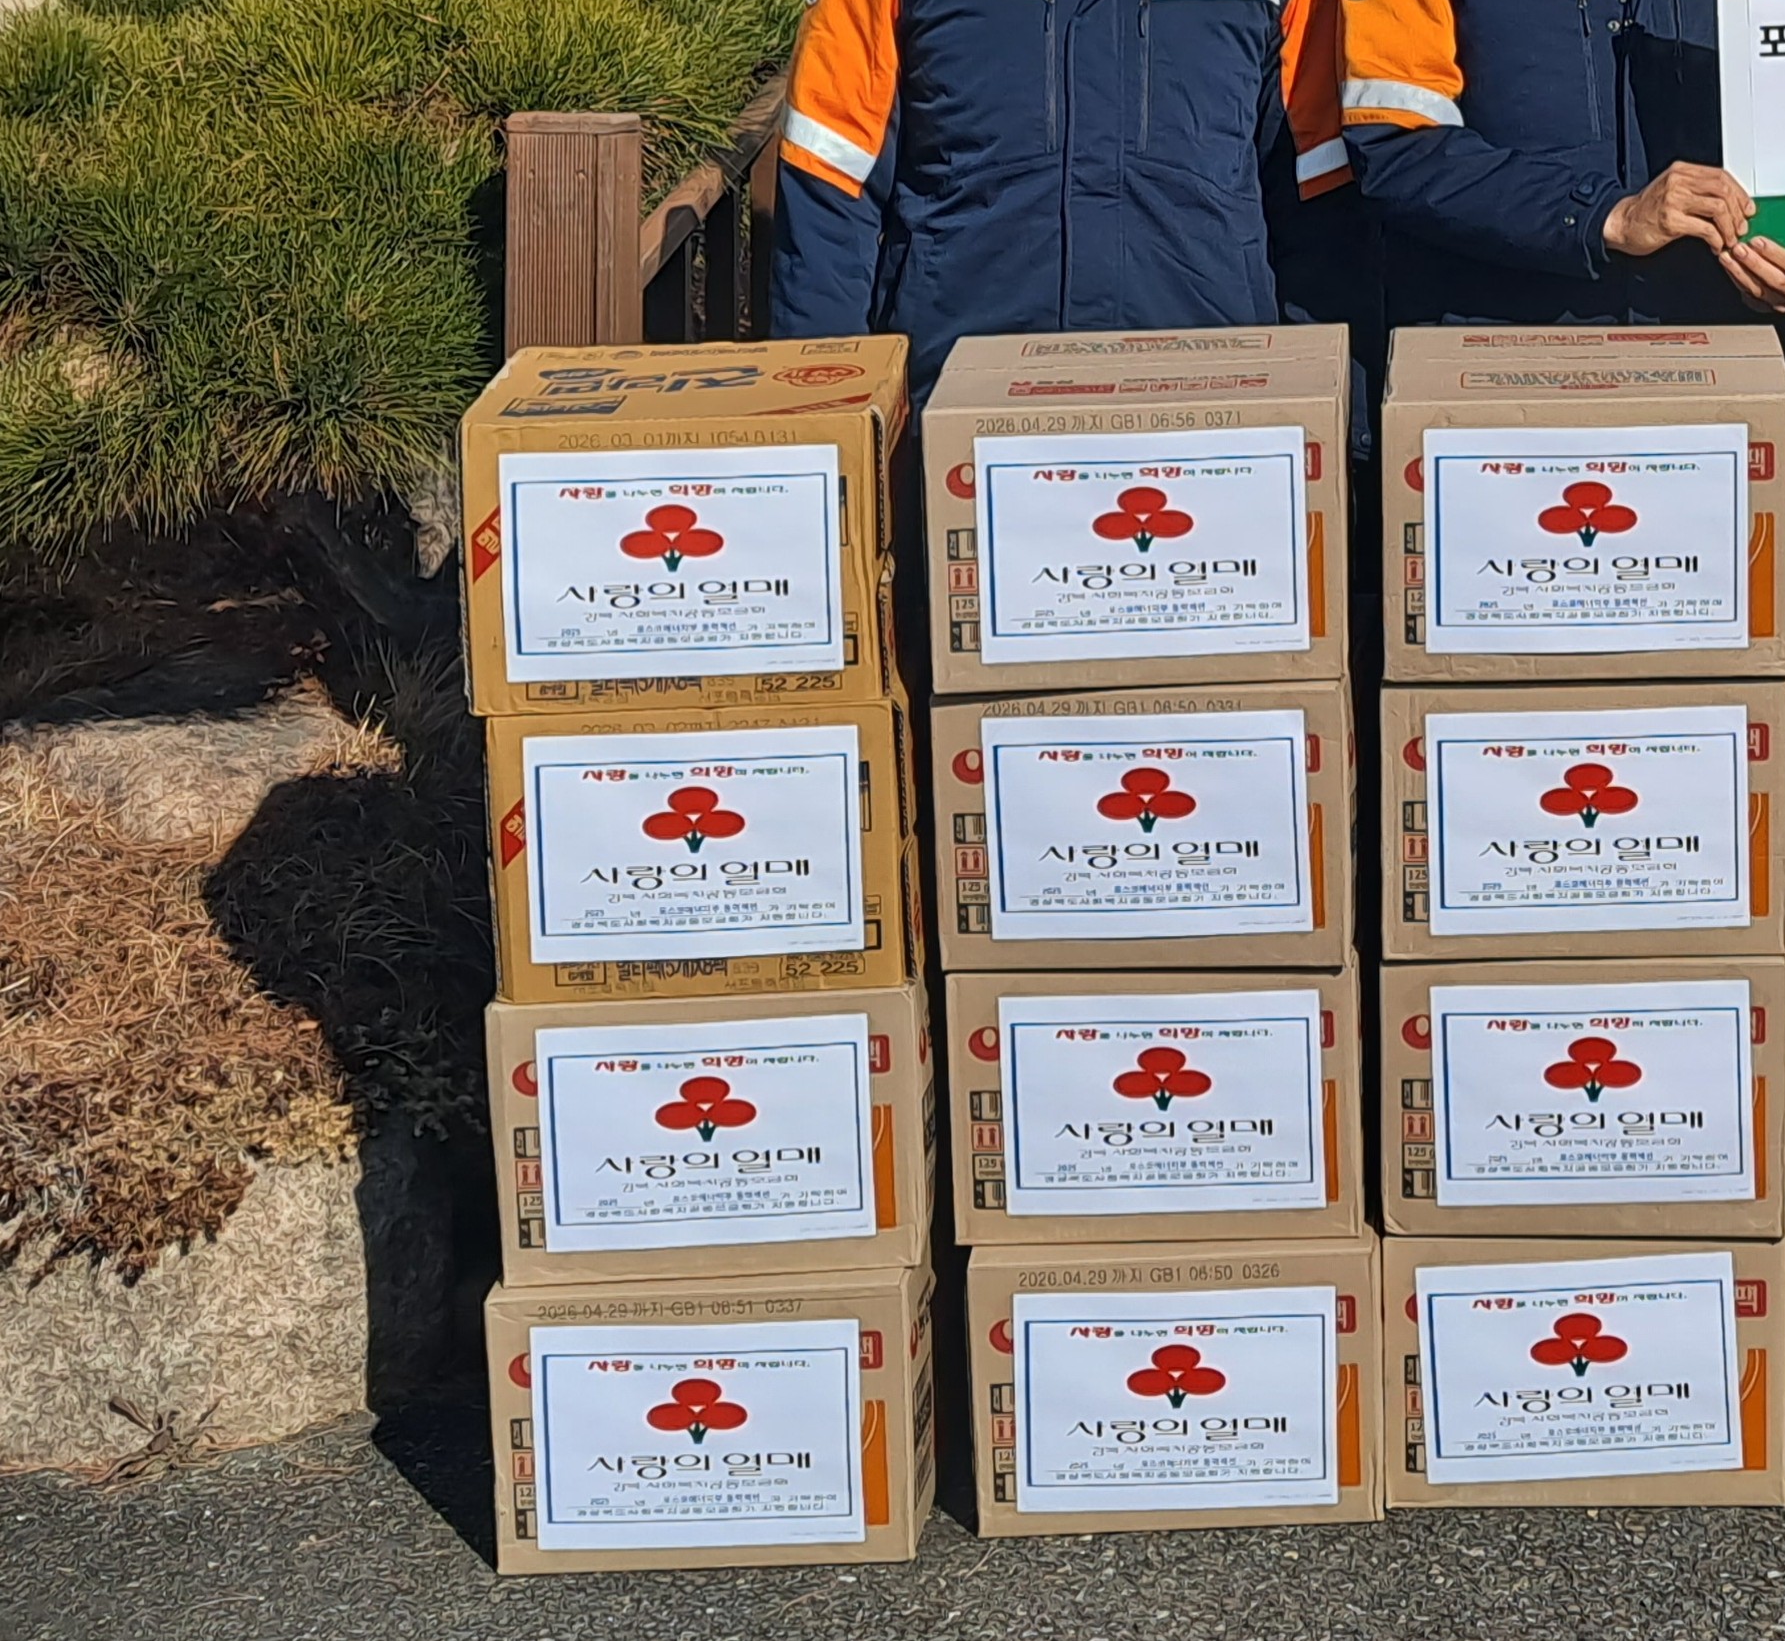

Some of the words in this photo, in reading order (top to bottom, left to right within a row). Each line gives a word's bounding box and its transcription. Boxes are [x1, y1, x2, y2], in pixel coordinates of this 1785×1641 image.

[1030, 562, 1157, 593] 사랑의
[1475, 557, 1600, 585] 사랑의
[556, 581, 686, 611] 사랑의
[1037, 842, 1161, 871] 사랑의
[1478, 837, 1602, 866] 사랑의
[579, 862, 708, 893] 사랑의
[1053, 1120, 1176, 1148] 사랑의
[1484, 1111, 1606, 1139] 사랑의
[593, 1151, 721, 1183] 사랑의
[1471, 1386, 1594, 1417] 사랑의
[1065, 1418, 1189, 1446] 사랑의
[585, 1453, 711, 1482] 사랑의
